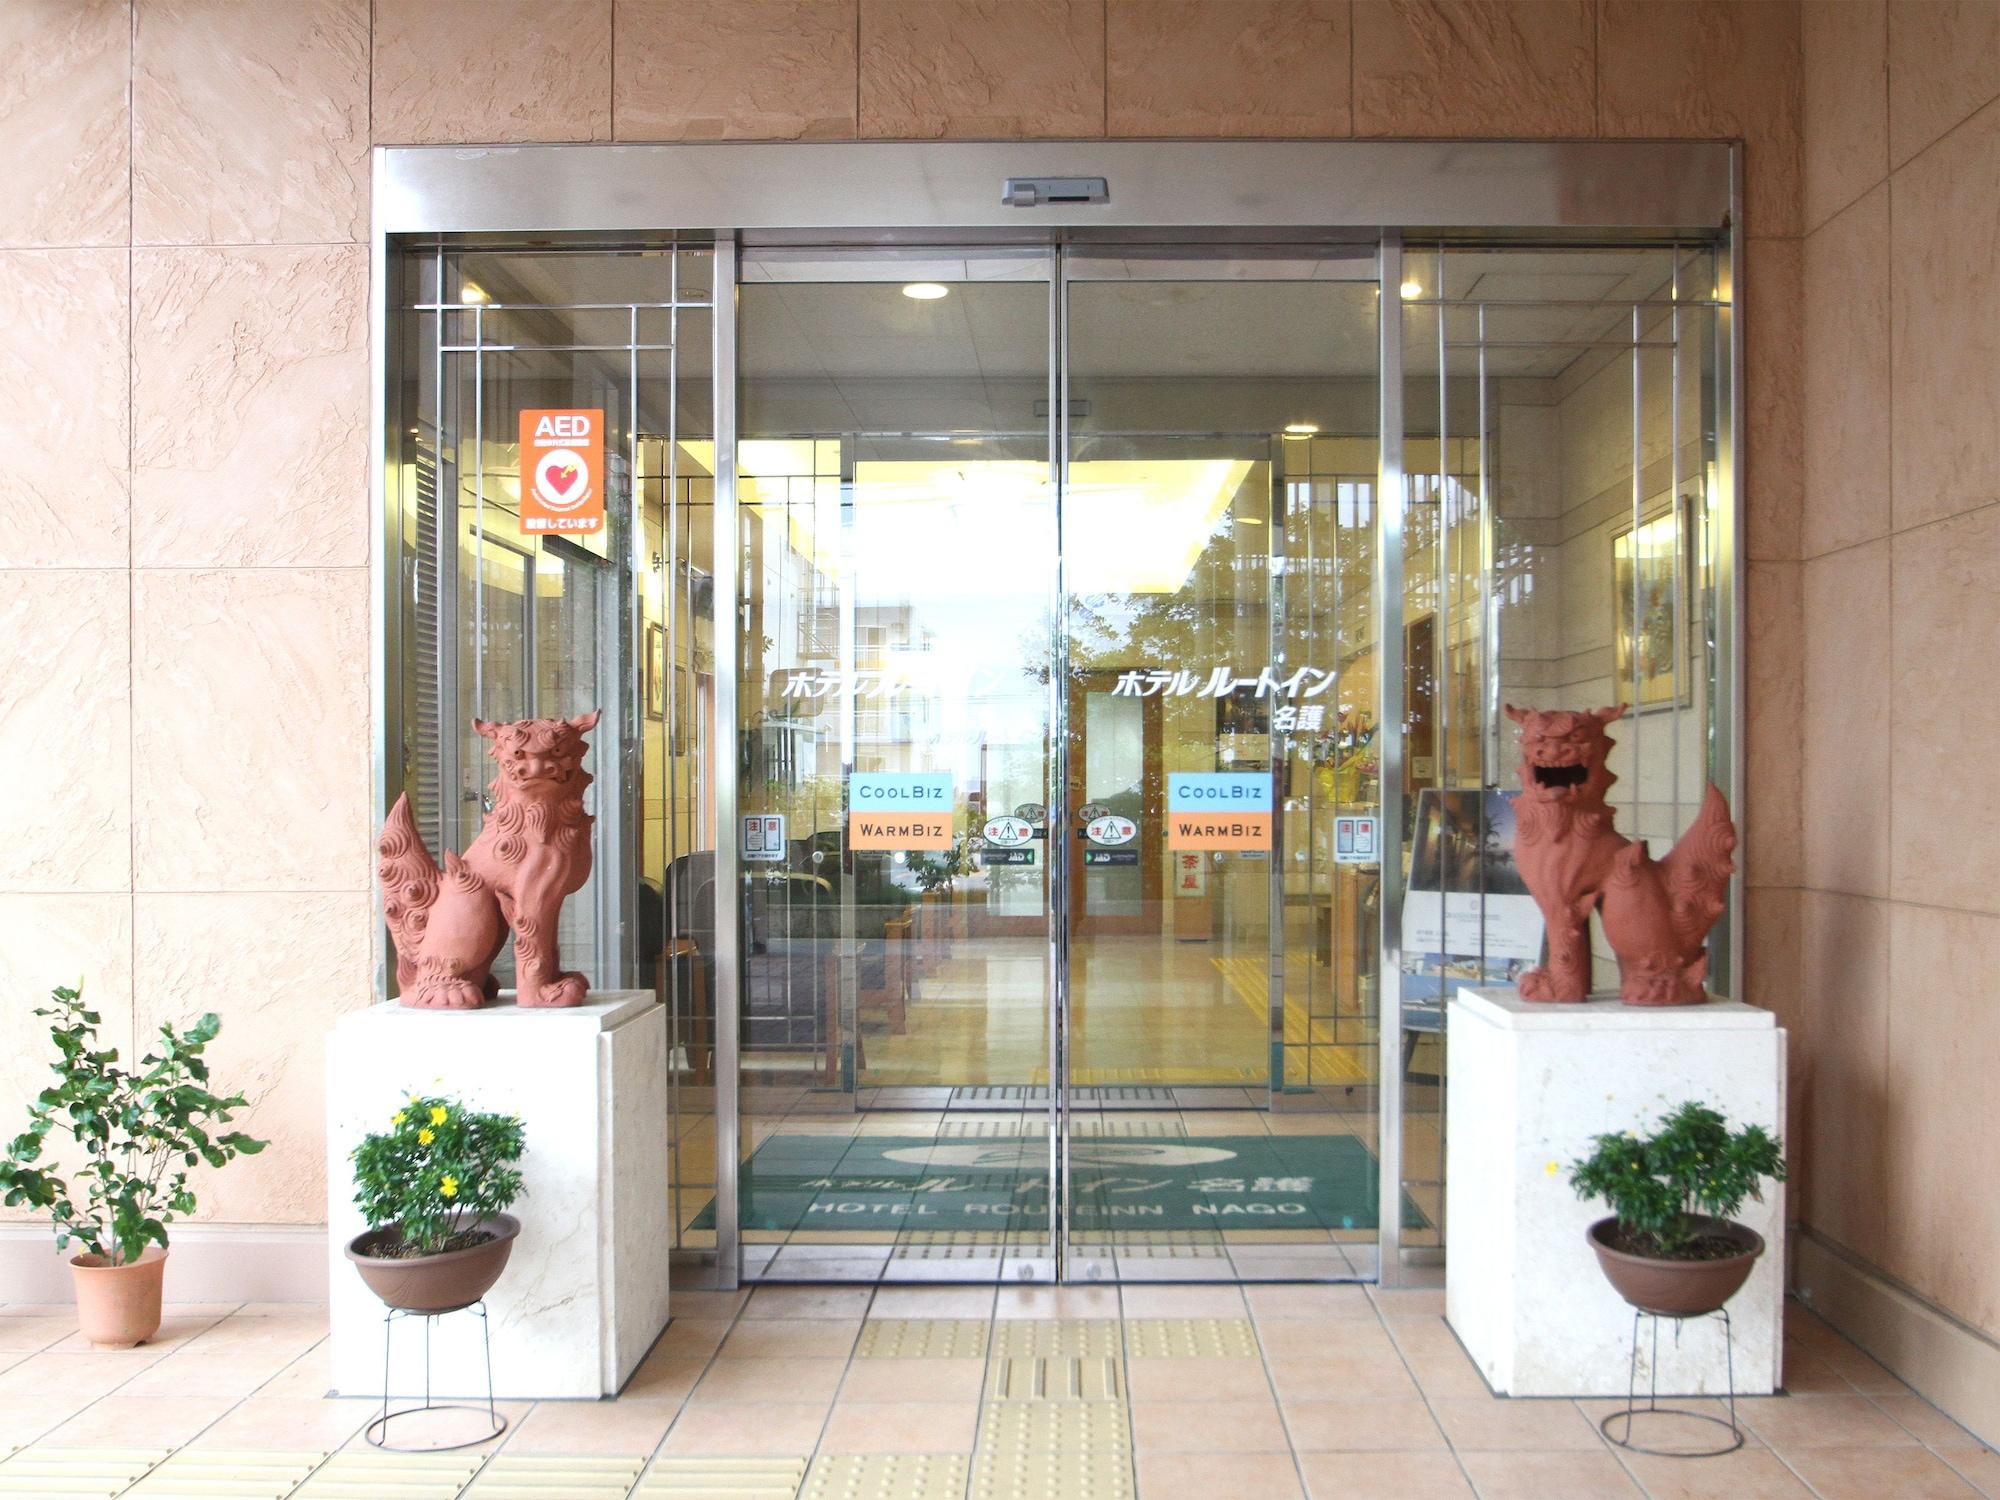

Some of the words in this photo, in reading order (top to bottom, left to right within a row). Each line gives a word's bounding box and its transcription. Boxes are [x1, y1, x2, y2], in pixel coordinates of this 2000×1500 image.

[535, 416, 590, 437] AED
[1273, 705, 1325, 731] 名護
[807, 1202, 938, 1215] HOTEL
[964, 1203, 1164, 1216] ROUEINN
[1192, 1202, 1307, 1215] NAGO
